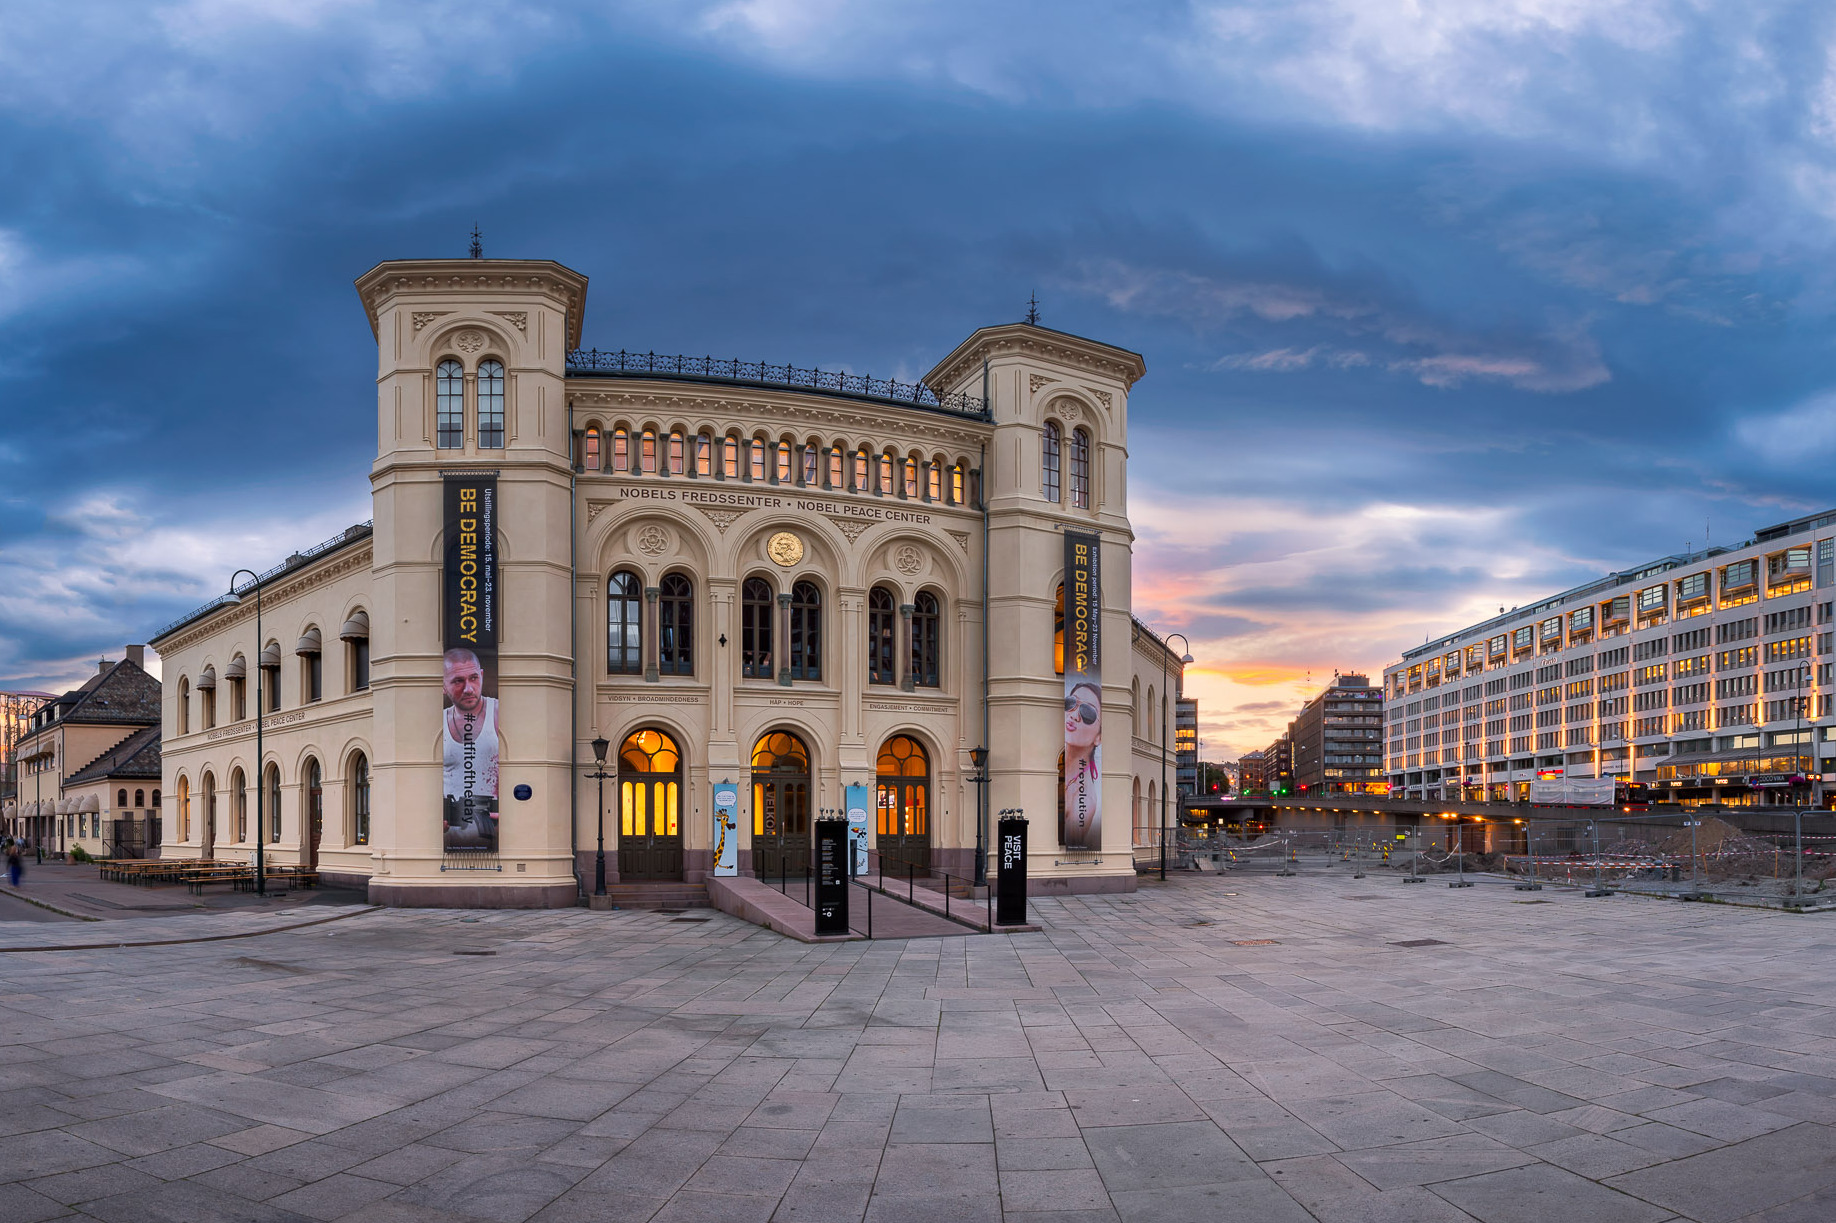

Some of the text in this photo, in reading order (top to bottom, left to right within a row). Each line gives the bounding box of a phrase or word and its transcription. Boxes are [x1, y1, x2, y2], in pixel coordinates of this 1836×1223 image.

[483, 488, 492, 552] Utstillingsperiode:
[620, 487, 931, 525] NOBELS FREDSSENTER NOBEL PEACE CENTER
[460, 488, 477, 643] BE DEMOCRACY
[484, 553, 492, 563] 15.
[484, 595, 492, 632] november
[1075, 543, 1088, 676] BE DEMOCRACY
[255, 721, 270, 729] NBEL
[270, 718, 285, 726] PEACE
[285, 712, 306, 722] CENTER
[869, 703, 908, 711] ENGASJEMENT
[462, 713, 477, 824] #outfitoftheday
[1078, 758, 1087, 828] #revolution
[1004, 835, 1012, 870] PEACE
[1012, 835, 1022, 861] VISIT
